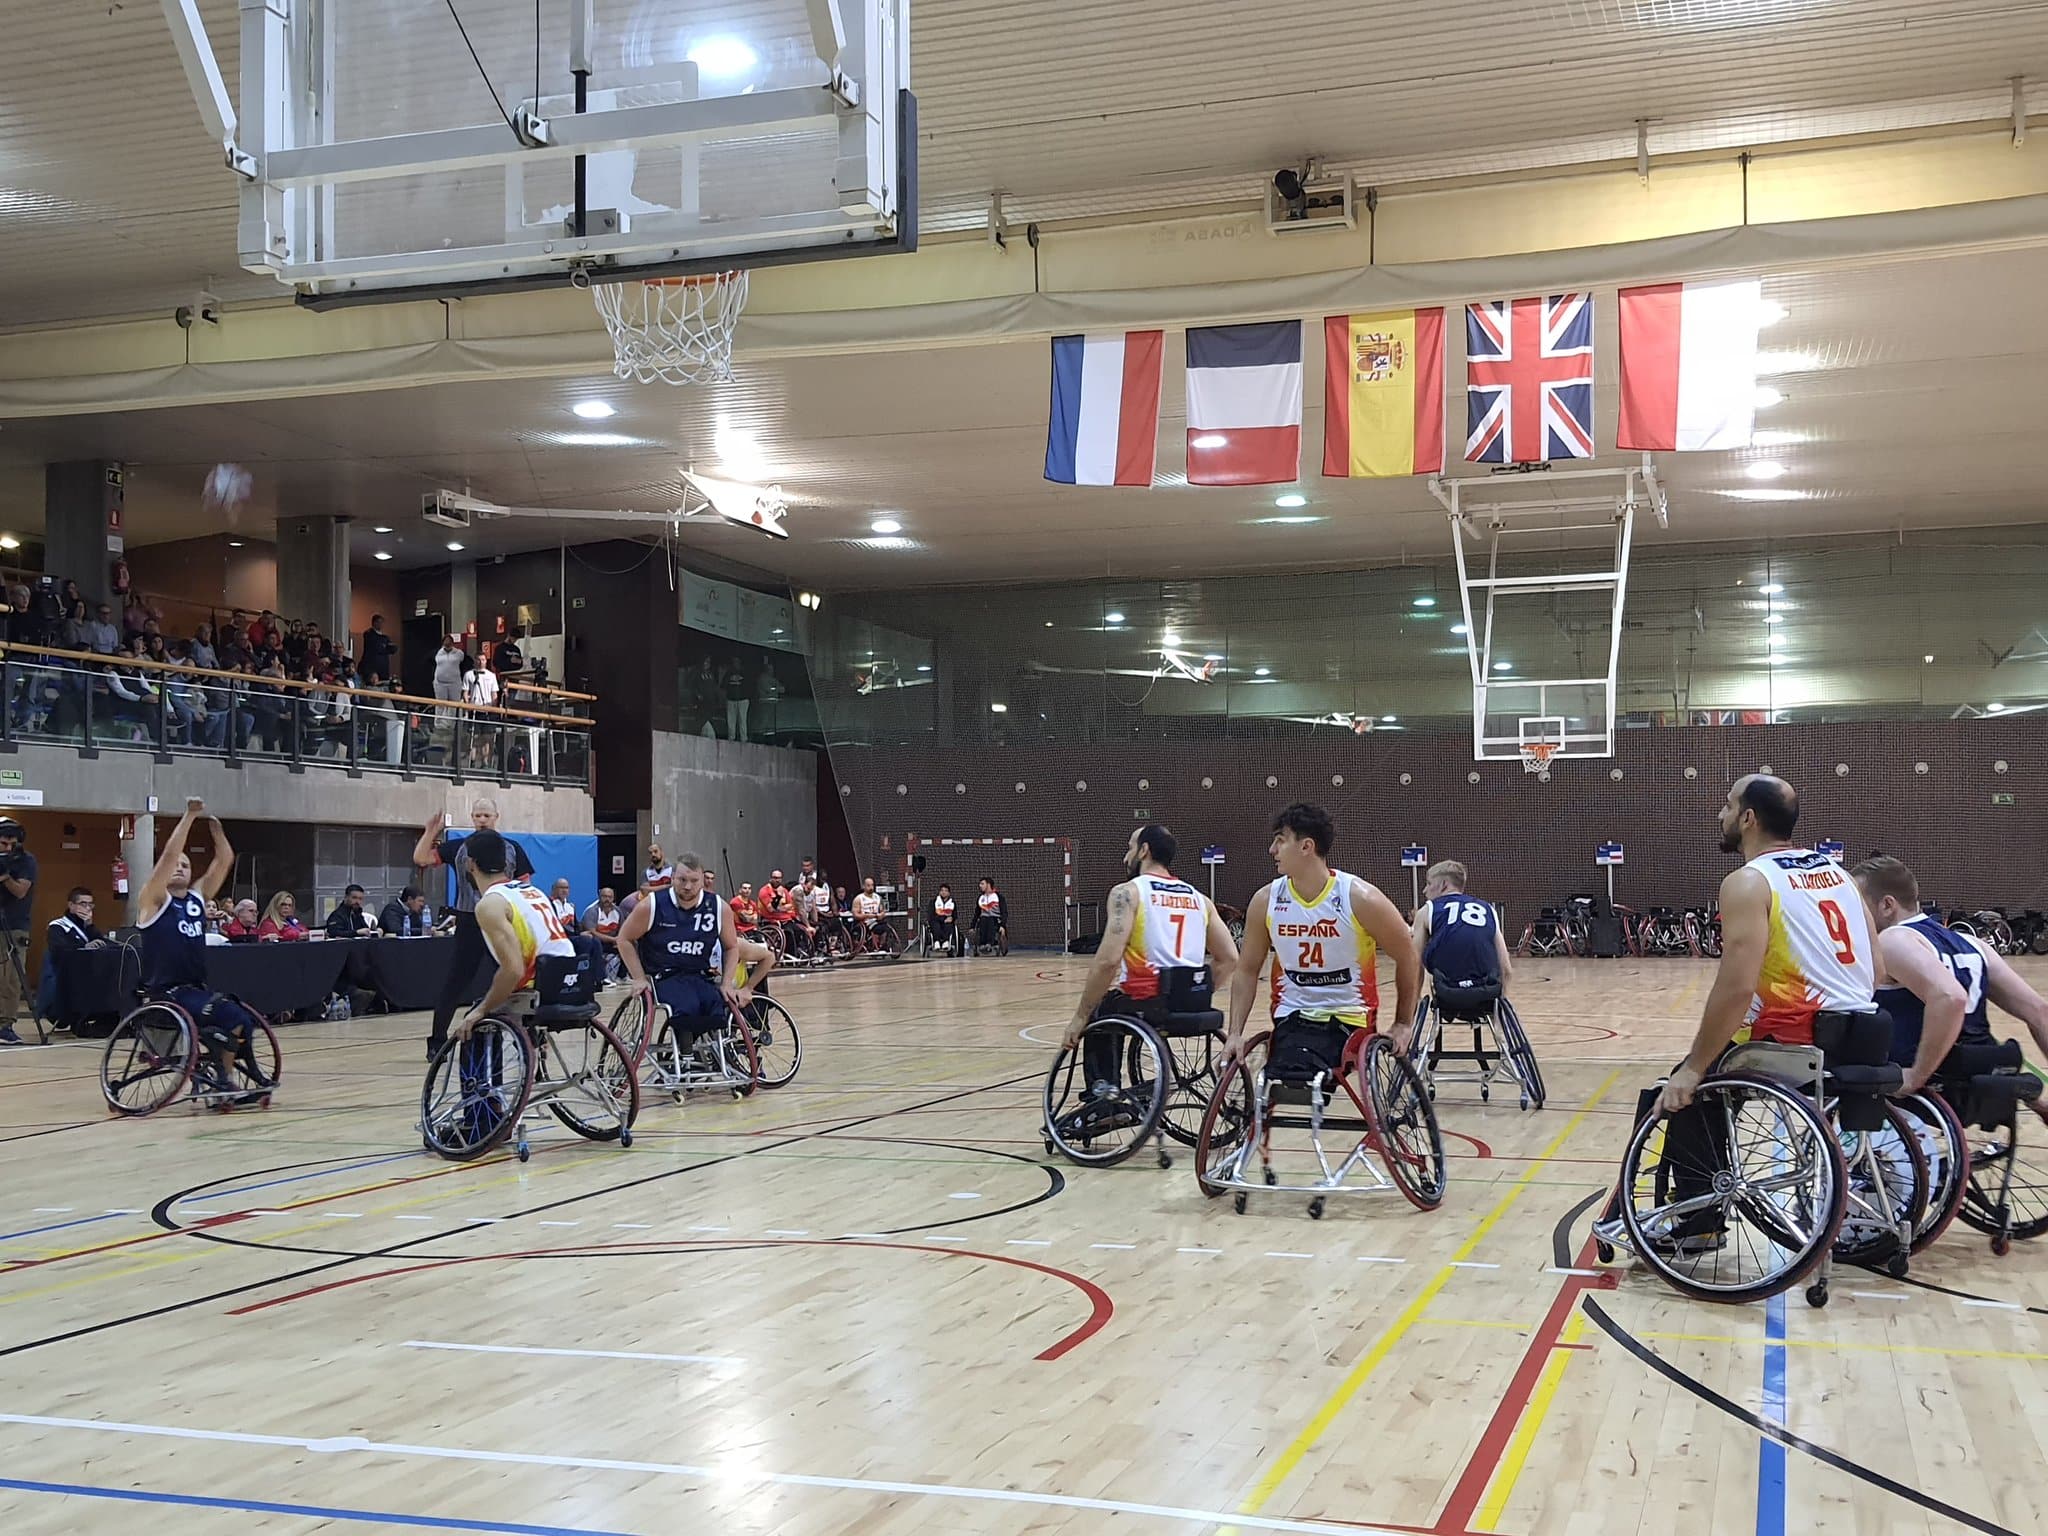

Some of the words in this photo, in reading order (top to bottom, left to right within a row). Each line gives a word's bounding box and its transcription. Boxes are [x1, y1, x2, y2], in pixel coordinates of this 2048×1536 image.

[187, 901, 202, 916] 6
[1443, 901, 1487, 927] 18
[178, 920, 203, 937] GBR
[693, 912, 715, 933] 13
[1278, 918, 1340, 937] ESPAÑA
[1818, 899, 1856, 966] 9
[667, 940, 704, 955] GBR
[1169, 914, 1187, 959] 7
[1298, 942, 1324, 968] 24
[1941, 952, 1984, 1014] 7
